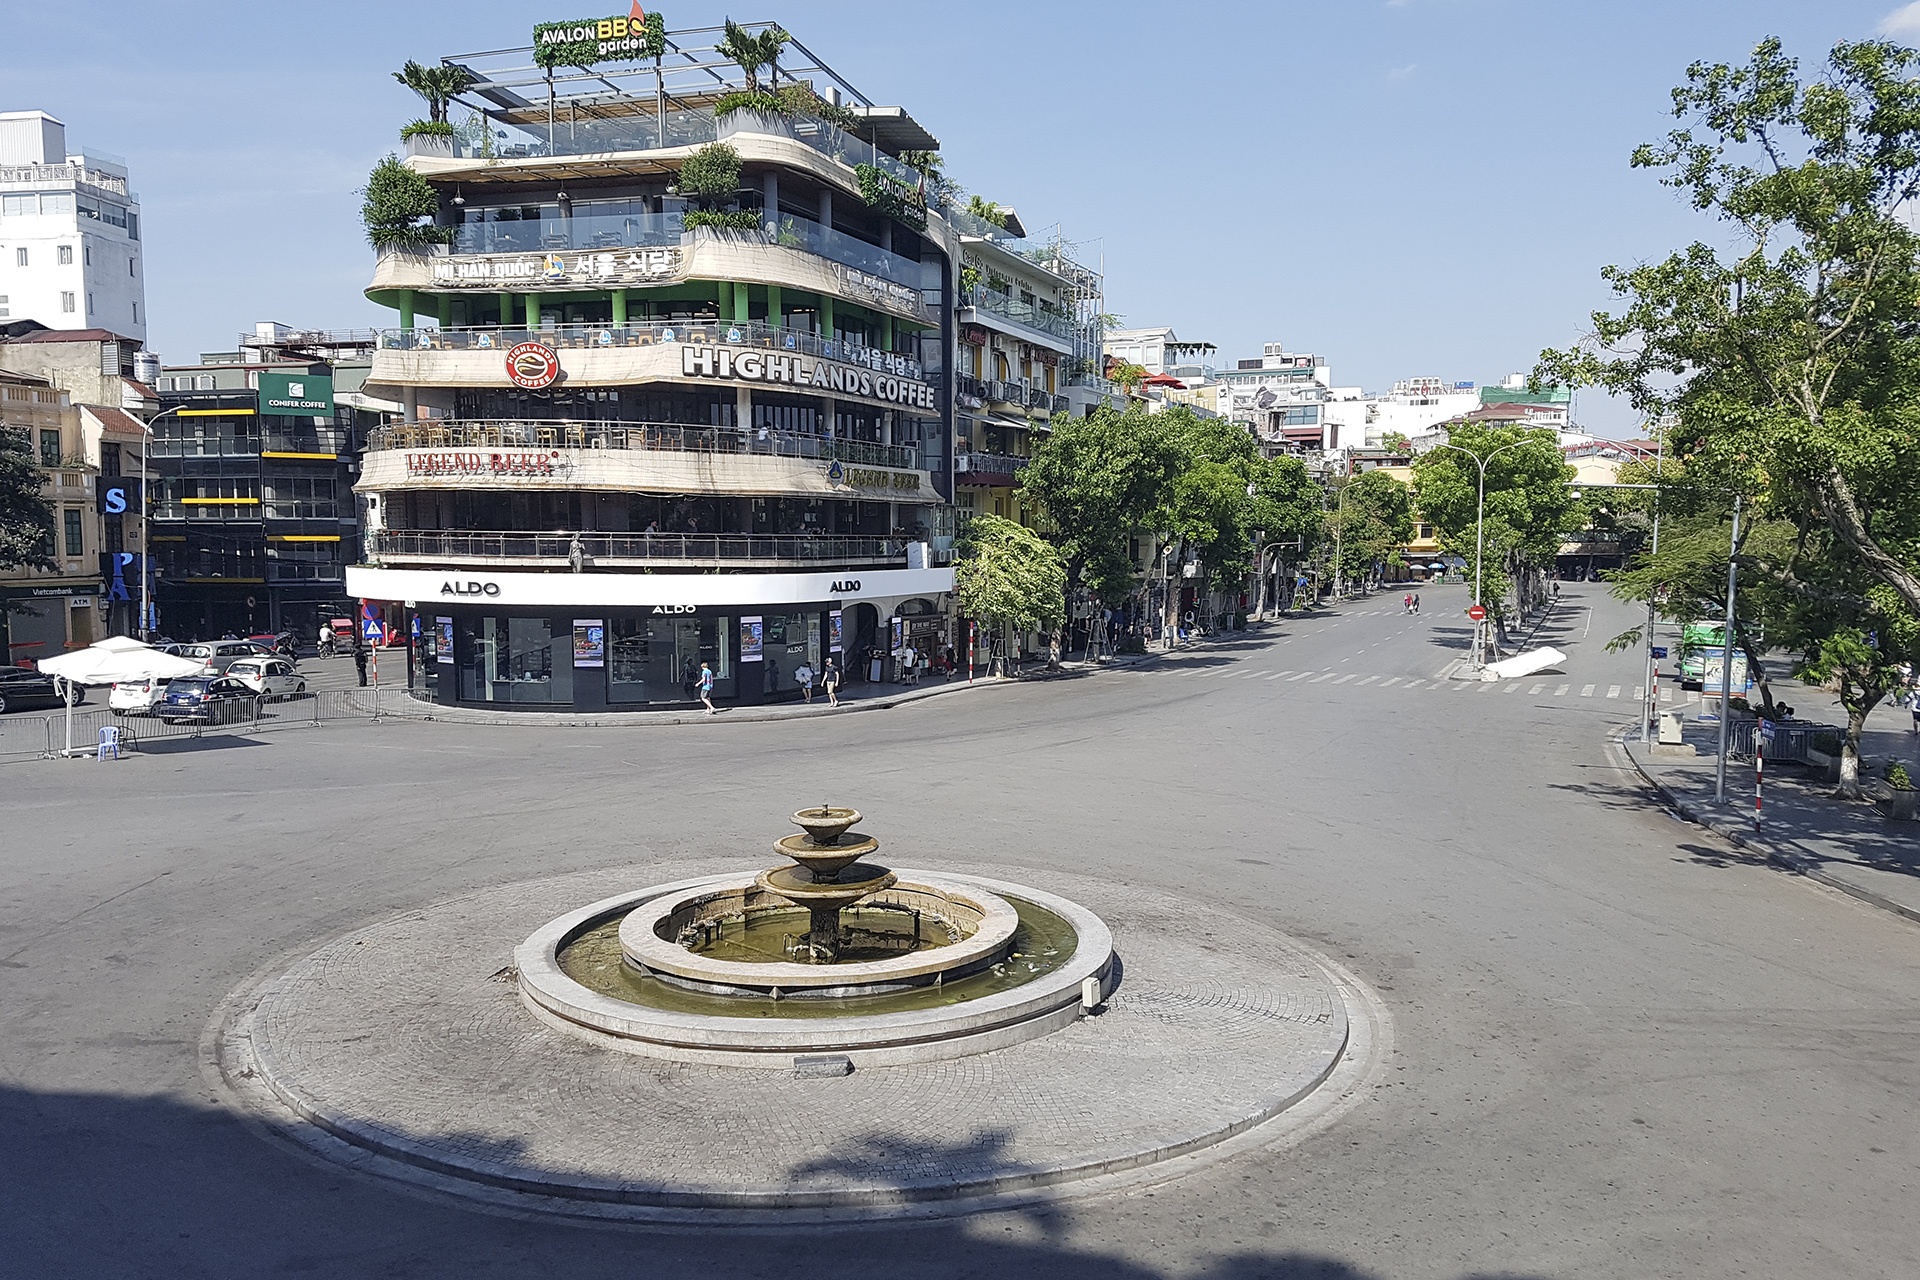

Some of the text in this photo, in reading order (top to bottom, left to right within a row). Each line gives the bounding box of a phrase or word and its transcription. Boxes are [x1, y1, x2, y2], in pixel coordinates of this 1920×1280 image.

[541, 14, 650, 44] AVALON BBQ
[599, 38, 647, 55] garden
[878, 175, 905, 199] AVALON
[903, 205, 924, 220] garden
[573, 250, 672, 276] 서울 식당
[507, 345, 555, 364] HIGHLANDS
[859, 343, 882, 371] 서울
[885, 352, 906, 376] 식당
[514, 374, 551, 387] COFFEE
[683, 346, 871, 396] HIGHLANDS
[875, 376, 935, 409] COFFEE
[268, 399, 326, 409] CONIFER COFFEE
[406, 453, 480, 471] LEGEND
[32, 587, 73, 595] Vietcombank
[440, 581, 500, 595] ALDO
[829, 580, 862, 593] ALDO
[652, 604, 696, 614] ALDO
[787, 646, 803, 654] ALDO
